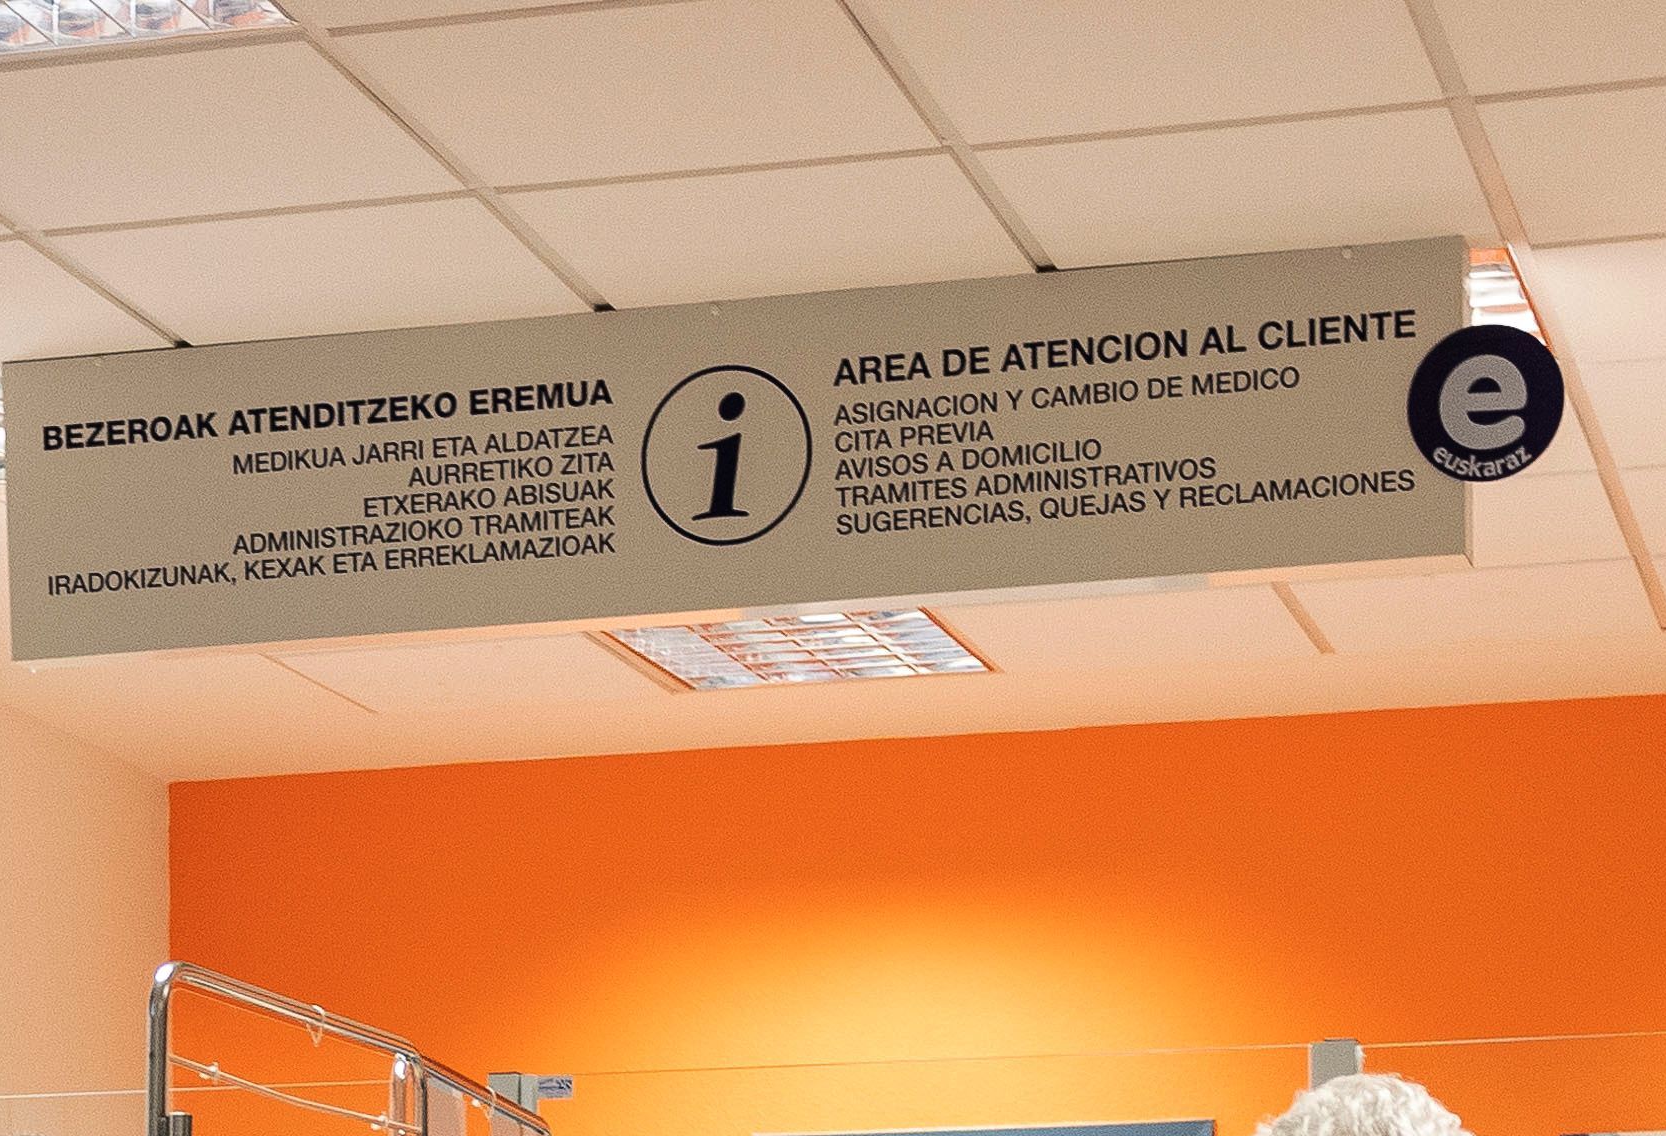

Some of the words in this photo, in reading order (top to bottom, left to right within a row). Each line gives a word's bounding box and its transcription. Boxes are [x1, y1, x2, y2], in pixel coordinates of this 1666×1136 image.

[833, 351, 932, 387] AREA
[942, 346, 991, 377] DE
[1000, 327, 1189, 373] ATENCION
[1199, 325, 1247, 356] AL
[1257, 309, 1417, 350] CLIENTE
[42, 412, 218, 451] BEZEROAK
[229, 391, 457, 436] ATENDITZEKO
[468, 379, 613, 416] EREMUA
[833, 392, 1003, 426] ASIGNACION
[1006, 389, 1023, 411] Y
[1030, 379, 1138, 410] CAMBIO
[1147, 376, 1185, 400] DE
[1191, 366, 1301, 397] MEDICO
[233, 449, 347, 475] MEDIKUA
[352, 440, 424, 466] JARRI
[433, 434, 477, 459] ETA
[483, 424, 614, 455] ALDATZEA
[833, 428, 892, 454] CITA
[900, 420, 995, 448] PREVIA
[834, 452, 929, 482] AVISOS
[935, 450, 956, 473] A
[961, 437, 1102, 471] DOMICILIO
[1432, 446, 1533, 479] euskaraz
[407, 456, 553, 488] AURRETIKO
[560, 451, 614, 476] ZITA
[836, 476, 968, 509] TRAMITES
[975, 456, 1217, 498] ADMINISTRATIVOS
[363, 488, 497, 518] ETXERAKO
[503, 478, 615, 507] ABISUAK
[836, 500, 1032, 536] SUGERENCIAS,
[1039, 490, 1146, 521] QUEJAS
[1152, 487, 1171, 510] Y
[1179, 469, 1416, 509] RECLAMACIONES
[232, 517, 463, 556] ADMINISTRAZIOKO
[470, 504, 615, 536] TRAMITEAK
[47, 561, 238, 596] IRADOKIZUNAK,
[244, 554, 325, 582] KEXAK
[333, 550, 378, 574] ETA
[384, 531, 616, 571] ERREKLAMAZIOAK
